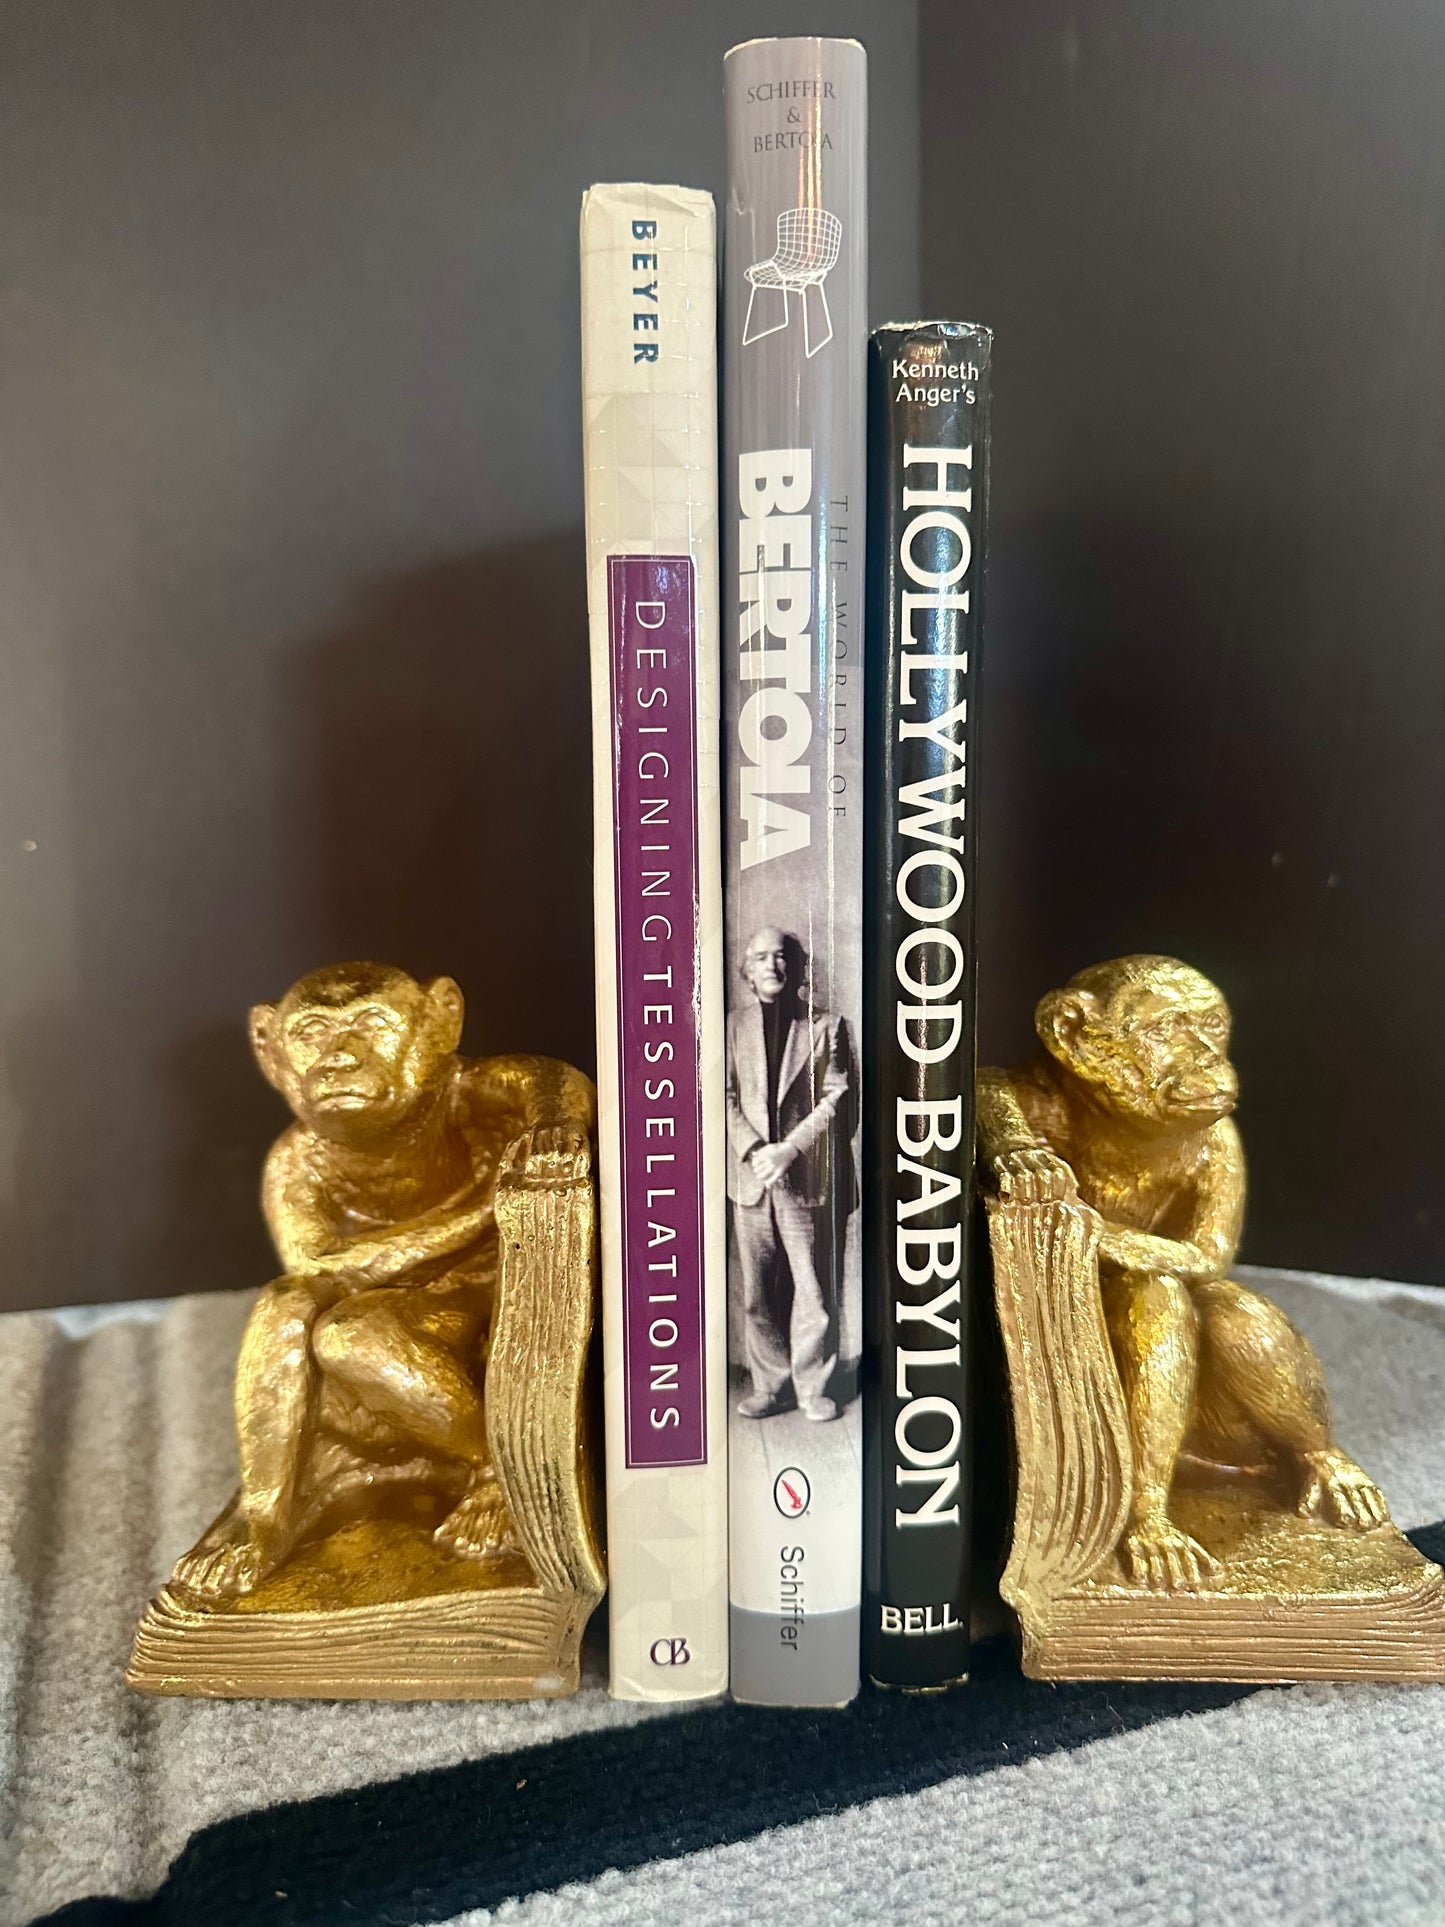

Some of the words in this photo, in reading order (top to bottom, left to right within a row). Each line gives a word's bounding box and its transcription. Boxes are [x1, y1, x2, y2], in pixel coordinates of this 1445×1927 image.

[754, 132, 833, 153] BERTOA
[786, 106, 801, 123] &
[631, 220, 659, 364] BEYER
[892, 360, 979, 382] Kenneth
[895, 384, 976, 406] Anger's
[830, 496, 848, 571] THE
[738, 449, 812, 870] BERTOIA
[635, 601, 671, 941] DESIGNING
[829, 775, 847, 817] OF
[896, 444, 973, 1064] HOLLYWOOD
[643, 966, 680, 1429] TESSELLATIONS
[894, 1095, 962, 1527] BABYLON
[780, 1545, 805, 1651] Schiffer
[649, 1637, 691, 1666] CB
